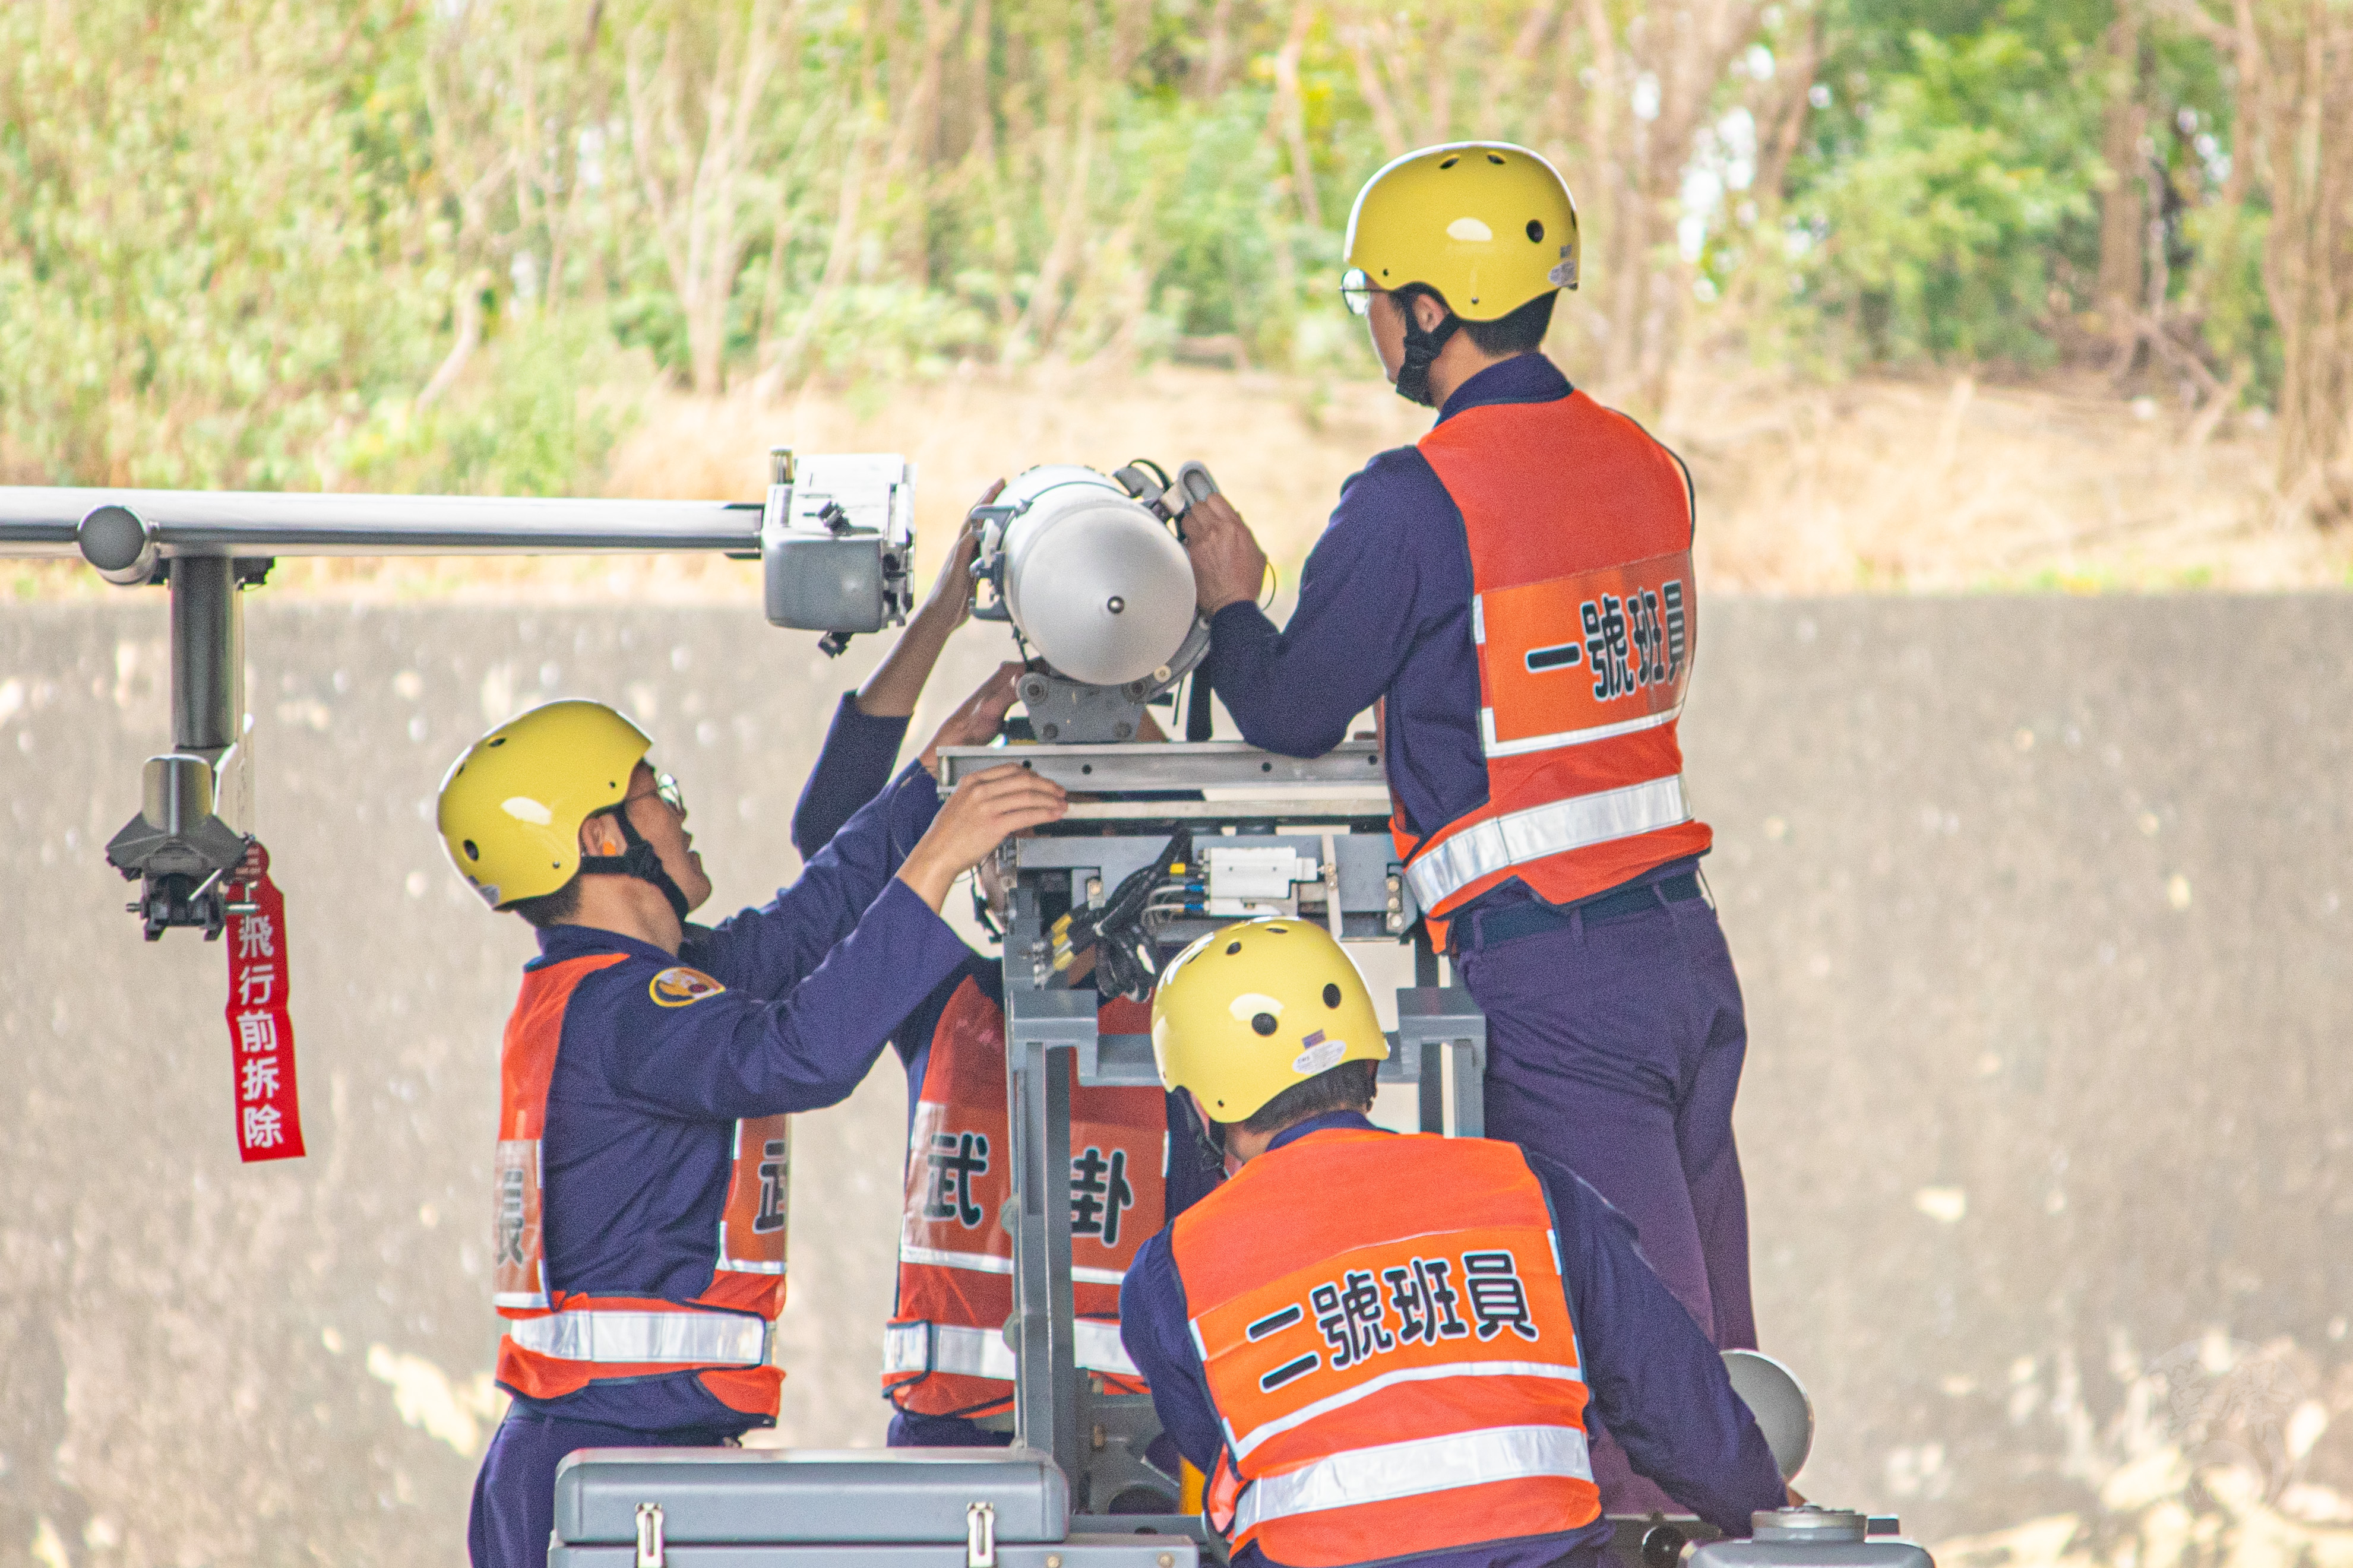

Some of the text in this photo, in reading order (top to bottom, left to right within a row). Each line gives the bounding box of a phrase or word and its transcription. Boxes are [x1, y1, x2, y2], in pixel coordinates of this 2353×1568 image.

[1526, 580, 1685, 701] 一號班員
[236, 915, 283, 1149] 飛行前拆除
[1247, 1250, 1538, 1392] 二號班員
